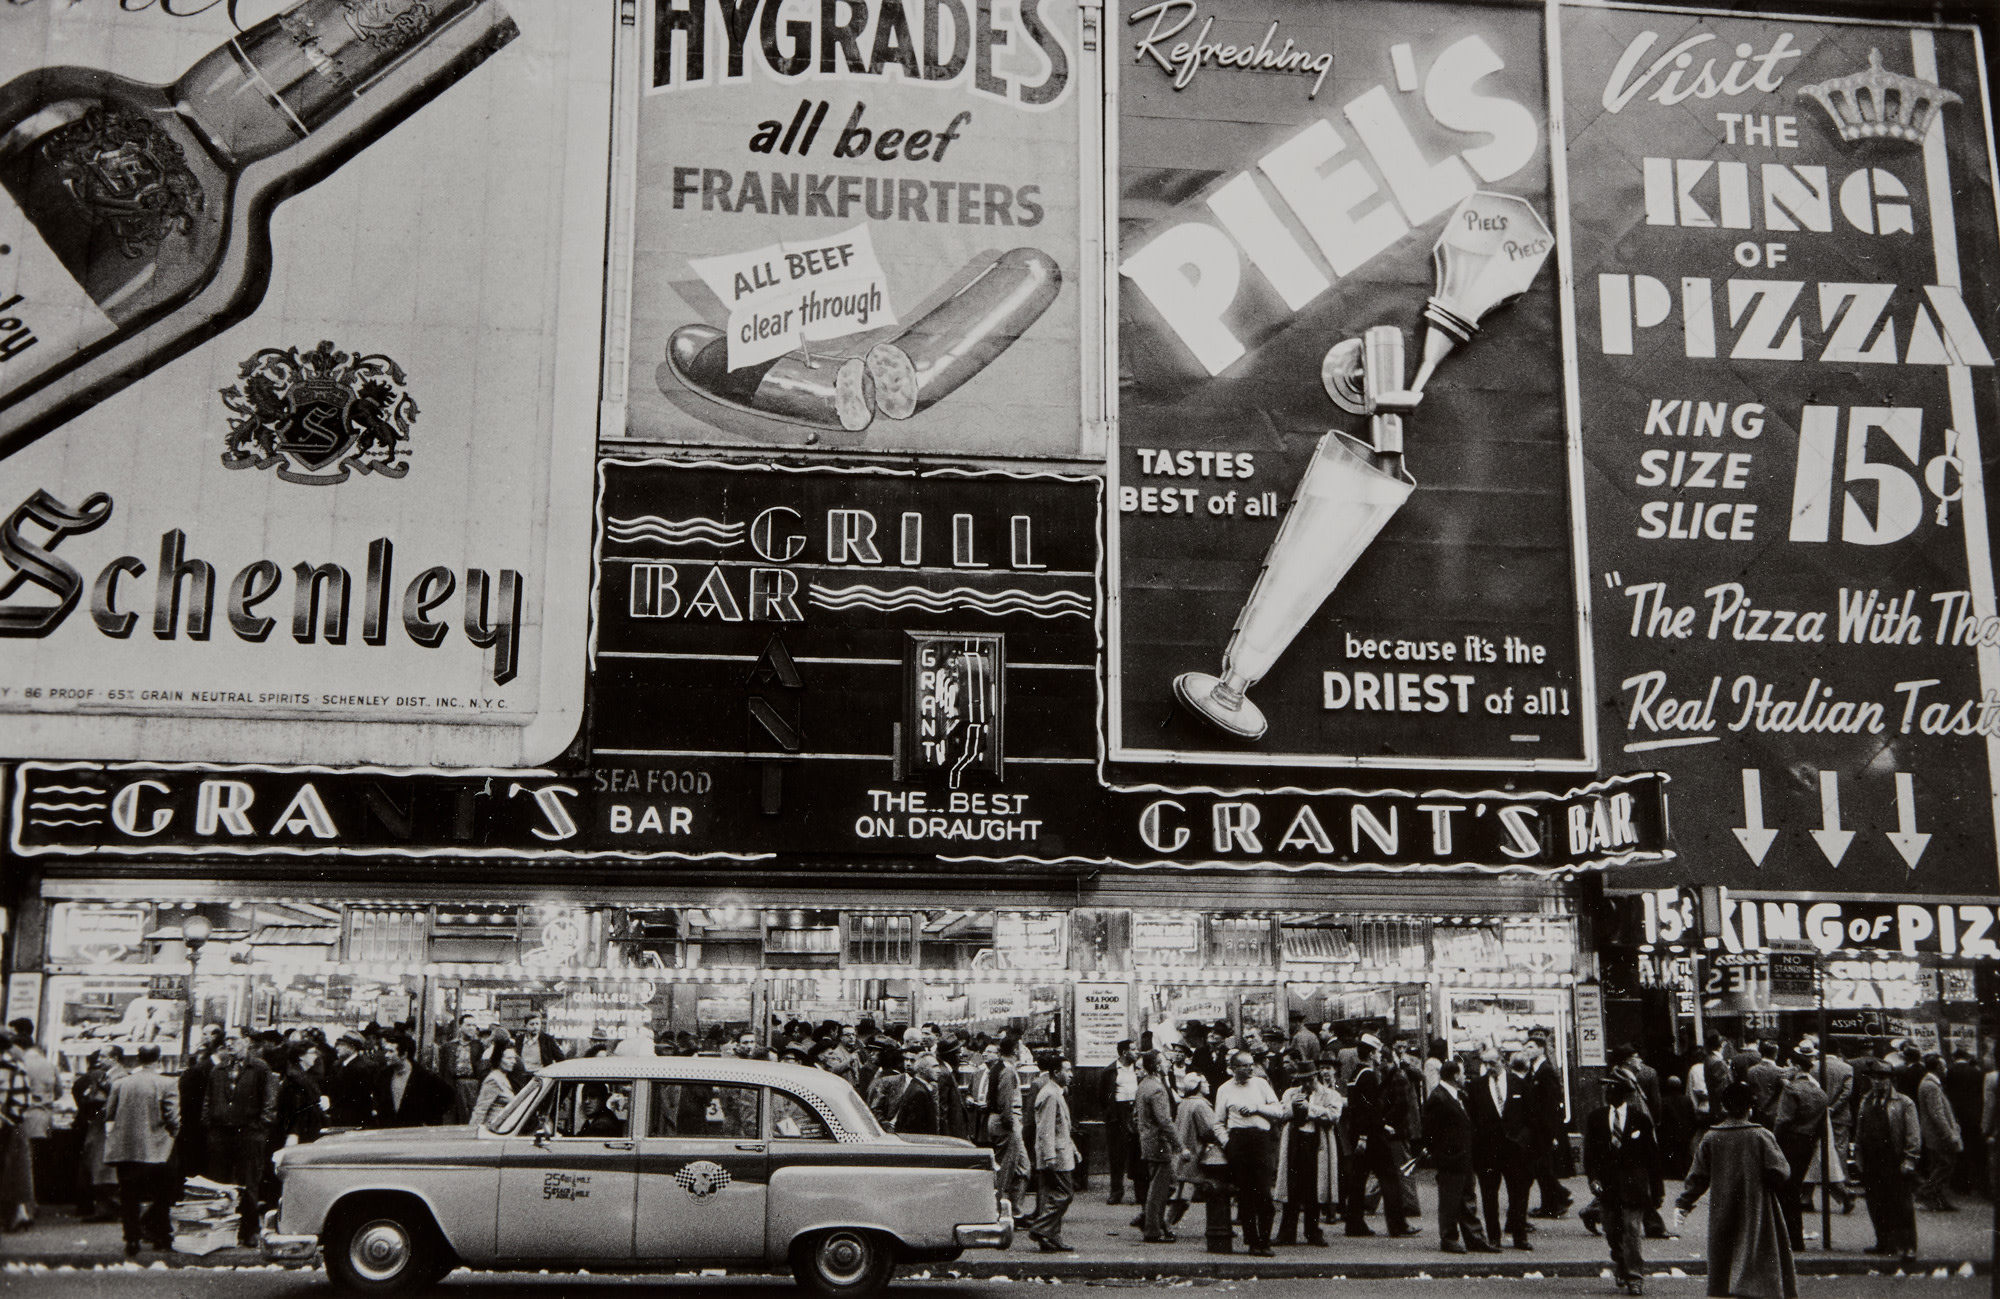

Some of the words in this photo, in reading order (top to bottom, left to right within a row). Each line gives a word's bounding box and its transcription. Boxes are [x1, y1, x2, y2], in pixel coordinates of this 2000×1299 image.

[652, 0, 1070, 105] HYGRADES
[1129, 0, 1334, 100] Refreshing
[1602, 30, 1801, 113] Visit
[749, 99, 829, 157] all
[833, 101, 971, 162] beef
[1717, 112, 1799, 148] THE
[672, 166, 1045, 228] FRANKFURTERS
[1119, 35, 1538, 377] PIEL'S
[1643, 157, 1914, 236] KING
[733, 261, 781, 301] ALL
[784, 243, 855, 282] BEEF
[1734, 241, 1787, 269] OF
[740, 309, 793, 344] clear
[799, 282, 881, 329] through
[1598, 273, 1995, 366] PIZZA
[1644, 399, 1765, 439] KING
[1137, 448, 1255, 479] TASTES
[1636, 449, 1752, 489] SIZE
[1119, 487, 1199, 514] BEST
[1208, 492, 1236, 517] of
[1245, 491, 1277, 517] all
[1637, 501, 1758, 541] SLICE
[750, 506, 1047, 568] GRILL
[0, 488, 523, 686] Schenley
[630, 563, 804, 622] BAR
[1704, 582, 1828, 642] Pizza
[1838, 587, 1922, 645] With
[1346, 633, 1457, 663] because
[1505, 637, 1546, 665] the
[25, 688, 42, 699] 86
[50, 688, 94, 700] PROOF
[141, 690, 183, 701] GRAIN
[191, 691, 253, 703] NEUTRAL
[259, 693, 310, 704] SPIRITS
[322, 694, 389, 706] SCHENLEY
[1323, 671, 1475, 713] DRIEST
[1484, 688, 1514, 715] of
[1622, 670, 1721, 733] Real
[1728, 675, 1885, 734] Italian
[593, 769, 640, 795] SEA
[646, 769, 712, 796] FOOD
[868, 790, 927, 814] THE
[949, 793, 1030, 815] BEST
[609, 805, 694, 836] BAR
[856, 815, 894, 839] ON
[909, 817, 1043, 842] DRAUGHT
[1139, 800, 1541, 858] GRANT'S
[1568, 792, 1639, 855] BAR
[1719, 897, 1844, 954] KING
[1898, 904, 2000, 958] PIZ
[1774, 964, 1810, 974] STANDING
[1782, 955, 1802, 964] NO
